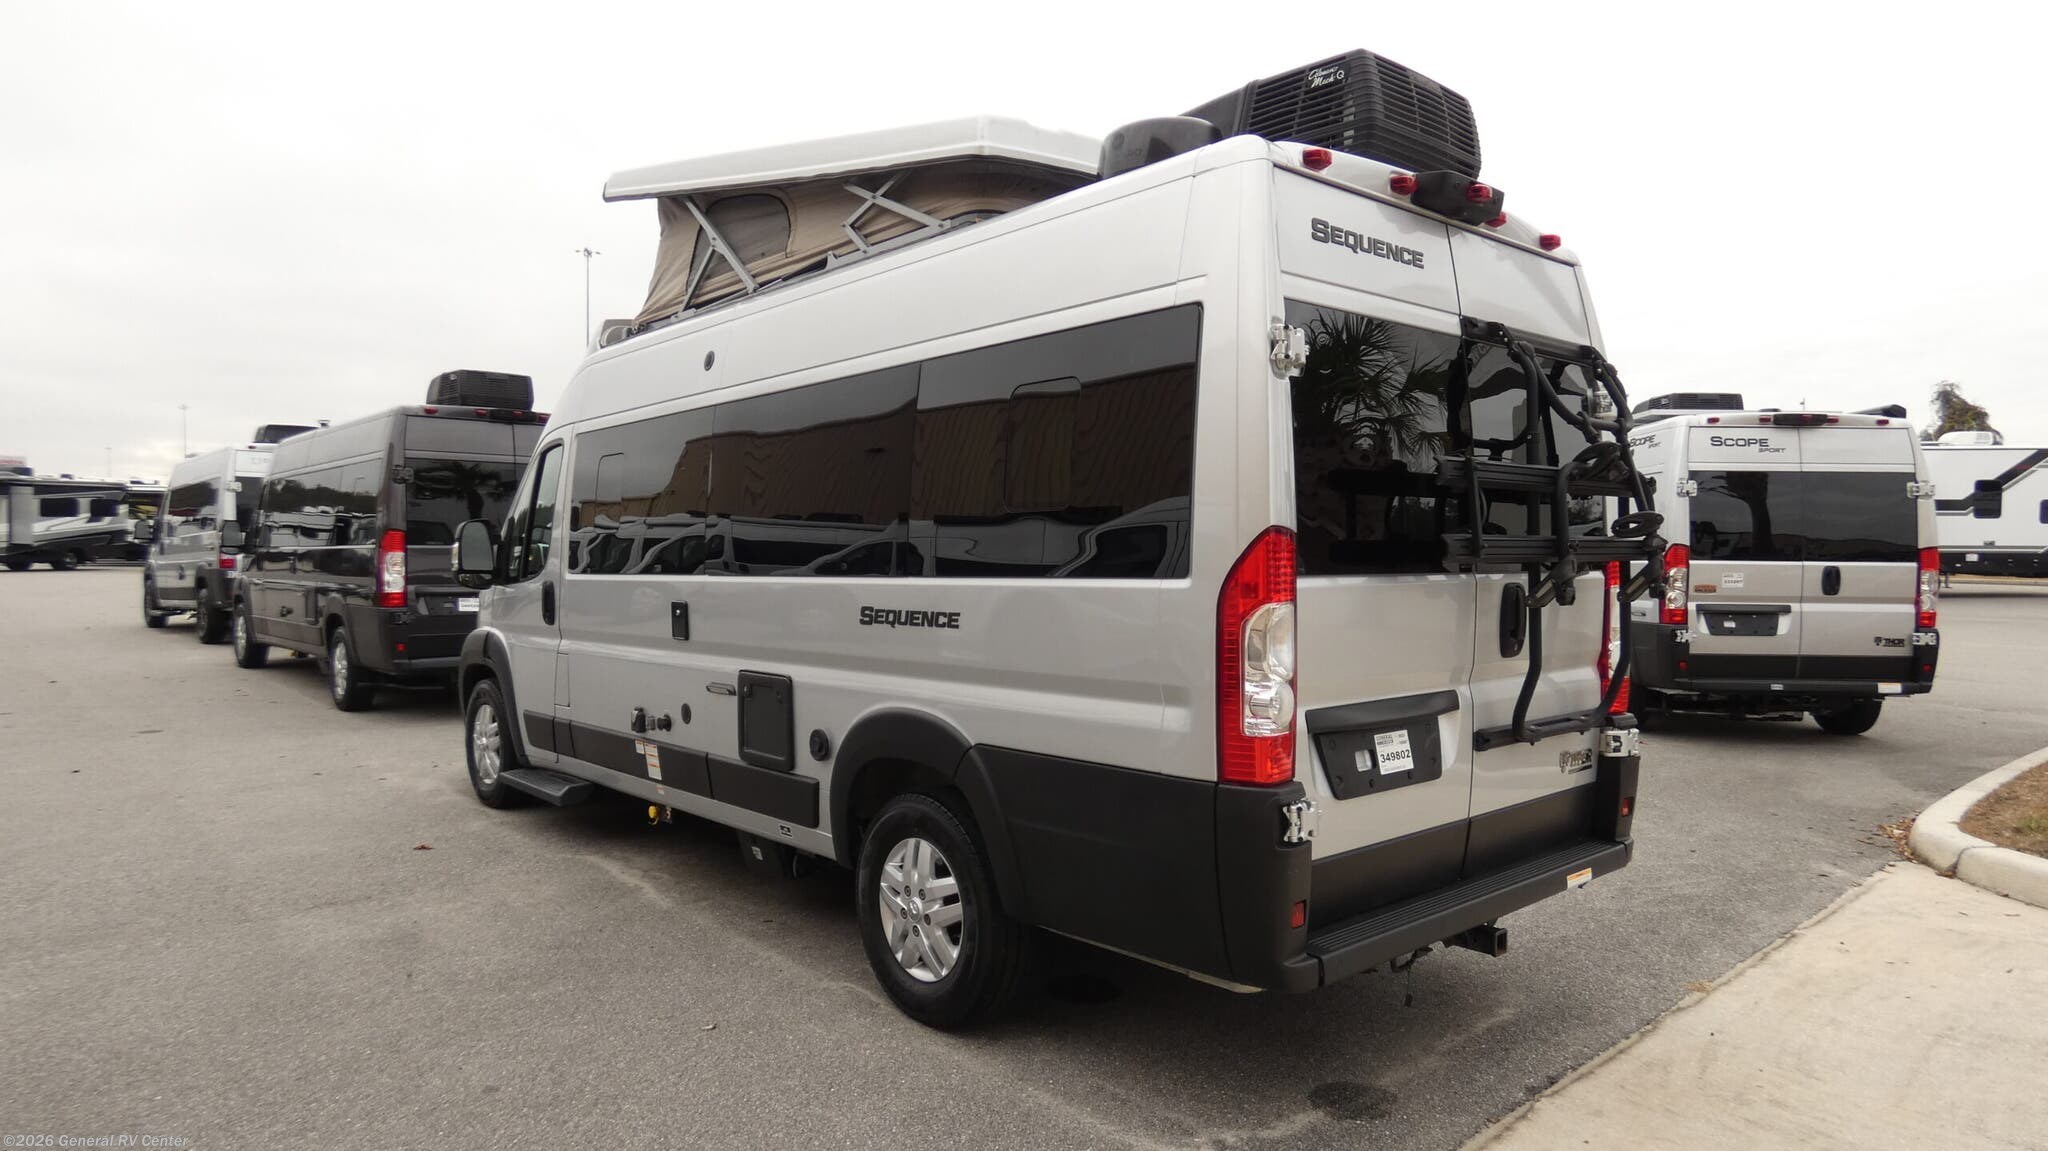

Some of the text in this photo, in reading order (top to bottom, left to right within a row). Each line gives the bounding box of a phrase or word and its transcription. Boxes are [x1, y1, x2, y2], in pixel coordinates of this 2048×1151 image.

[1311, 217, 1425, 269] SEQUENCE
[1710, 436, 1769, 447] SCOPE
[859, 606, 961, 629] SEQUENCE
[1380, 749, 1411, 763] 349802
